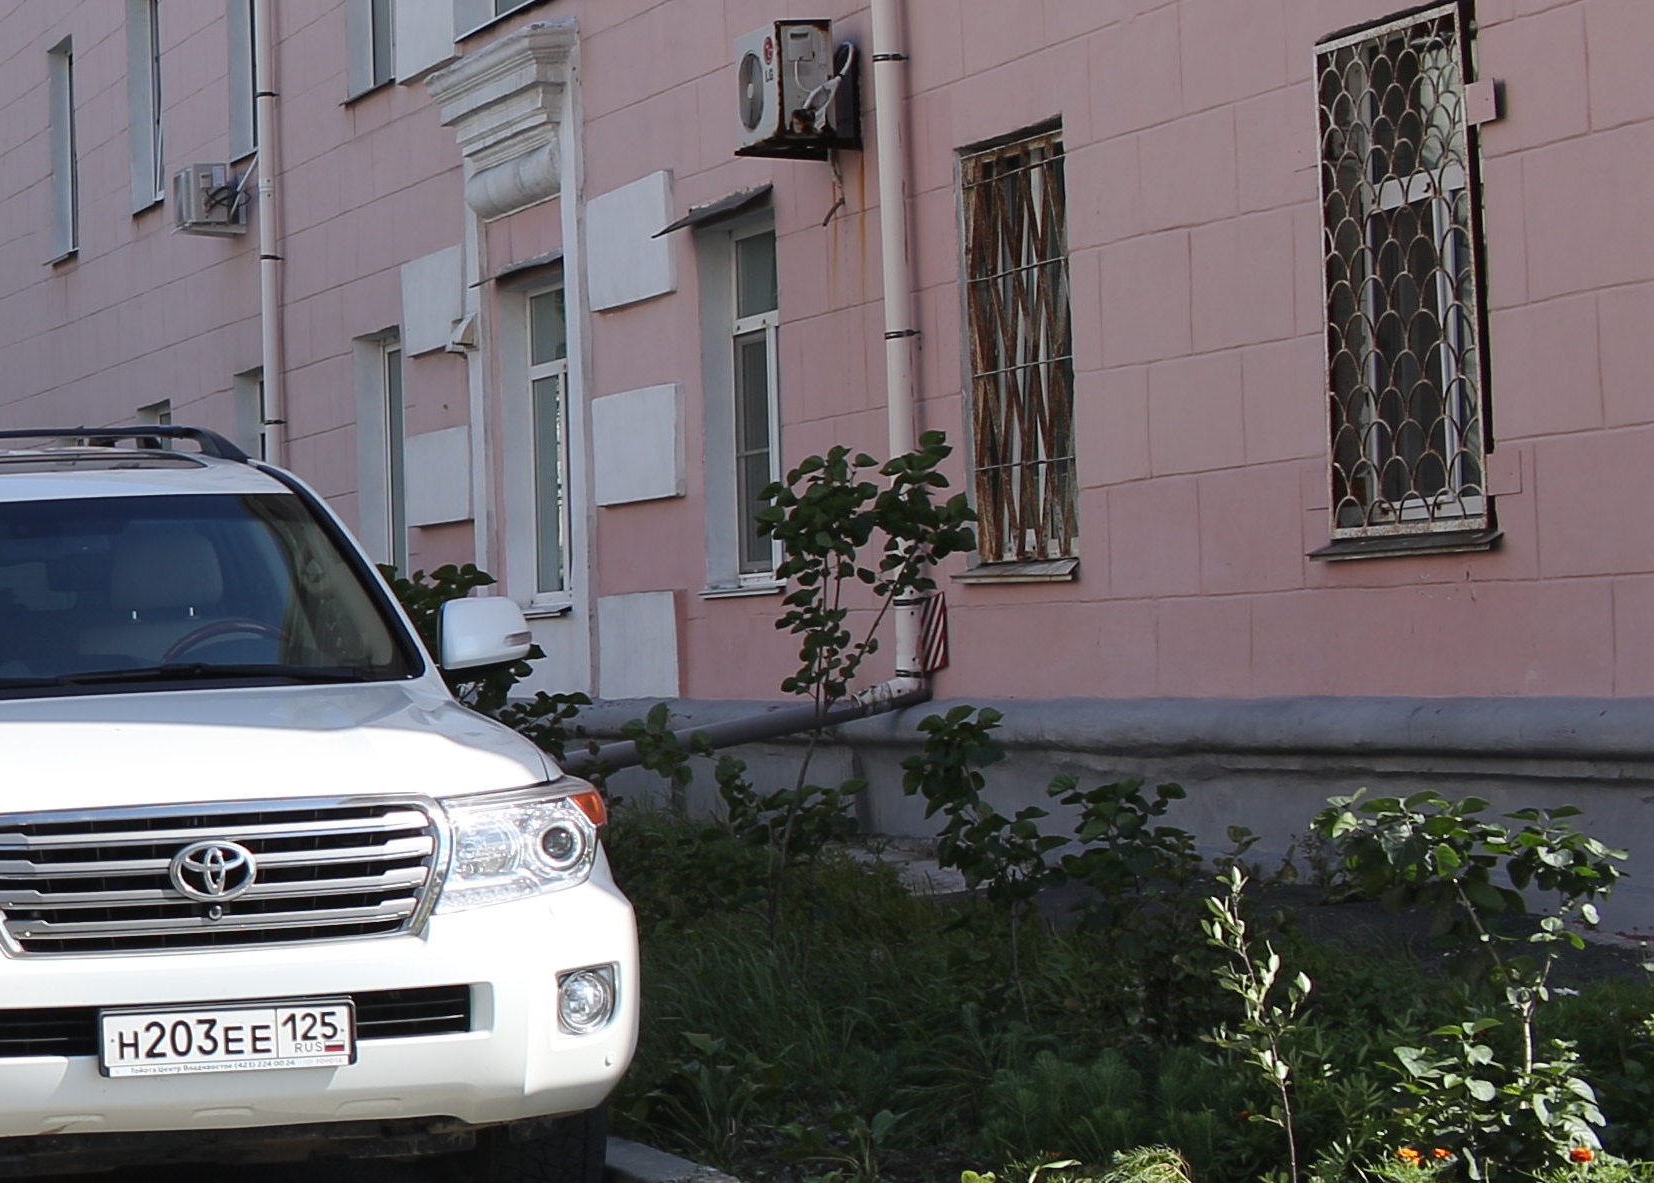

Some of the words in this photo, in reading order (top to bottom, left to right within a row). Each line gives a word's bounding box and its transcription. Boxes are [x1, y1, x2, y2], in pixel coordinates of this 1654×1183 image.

[118, 1018, 273, 1060] Н203ЕЕ
[281, 1011, 339, 1041] 125
[294, 1041, 323, 1054] RUS
